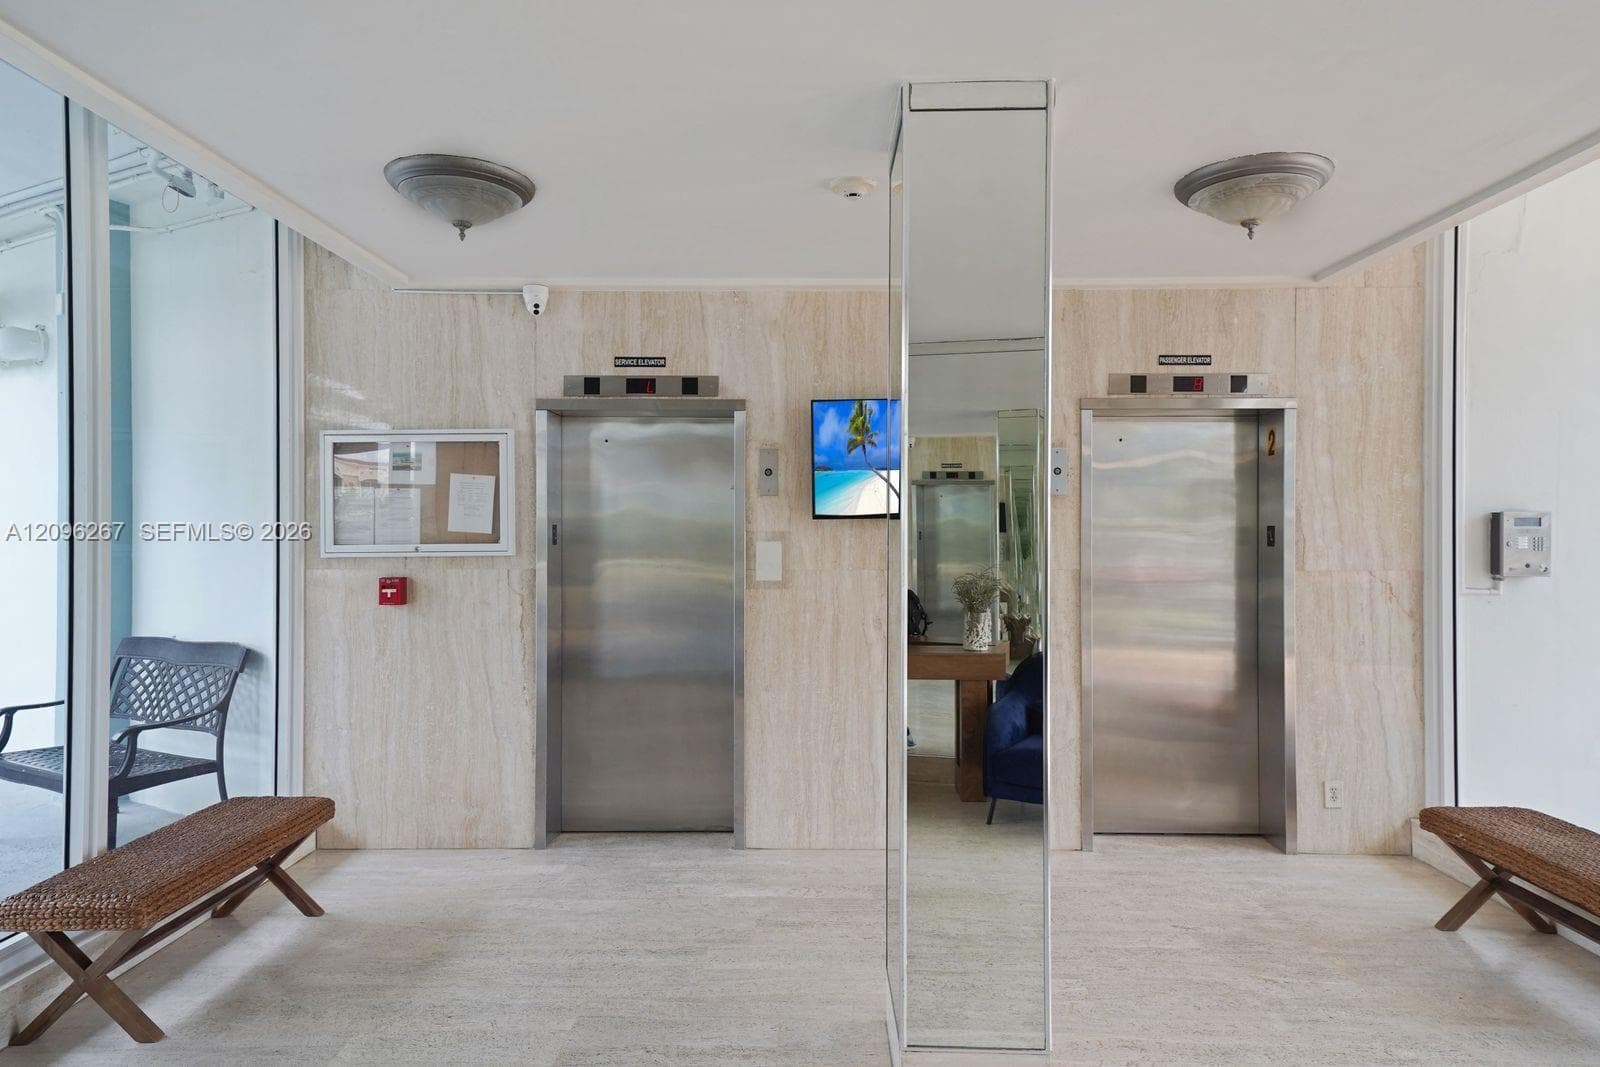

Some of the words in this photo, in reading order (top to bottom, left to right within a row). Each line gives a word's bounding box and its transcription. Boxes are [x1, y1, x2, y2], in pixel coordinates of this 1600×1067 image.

[615, 358, 637, 366] SERVICE
[638, 358, 665, 366] ELEVATOR
[1187, 356, 1211, 364] ELEVATOR
[1267, 429, 1276, 456] 2
